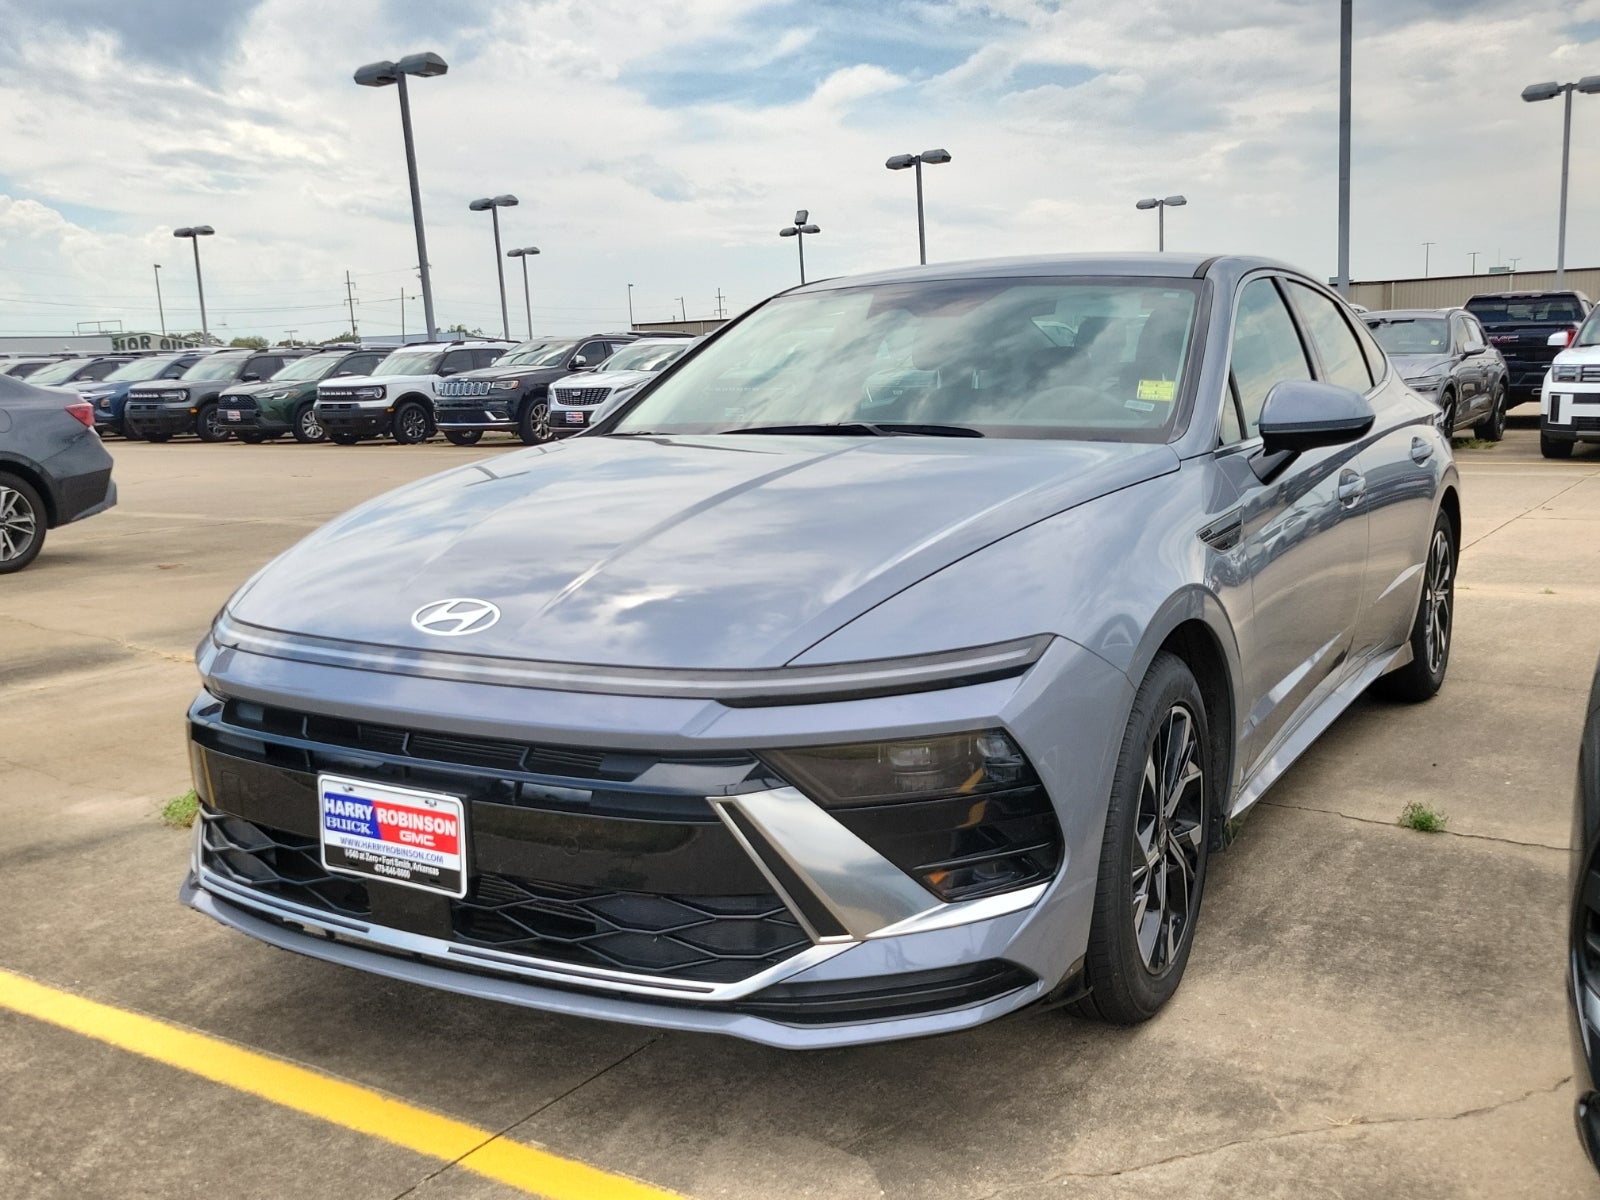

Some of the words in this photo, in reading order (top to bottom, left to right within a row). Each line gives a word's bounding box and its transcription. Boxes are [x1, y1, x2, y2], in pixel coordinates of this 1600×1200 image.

[324, 798, 374, 821] HARRY
[377, 807, 457, 837] ROBINSON
[326, 817, 372, 834] BUICK
[399, 830, 435, 847] GMC
[340, 836, 444, 864] WWW.HARRYROBINSON.COM
